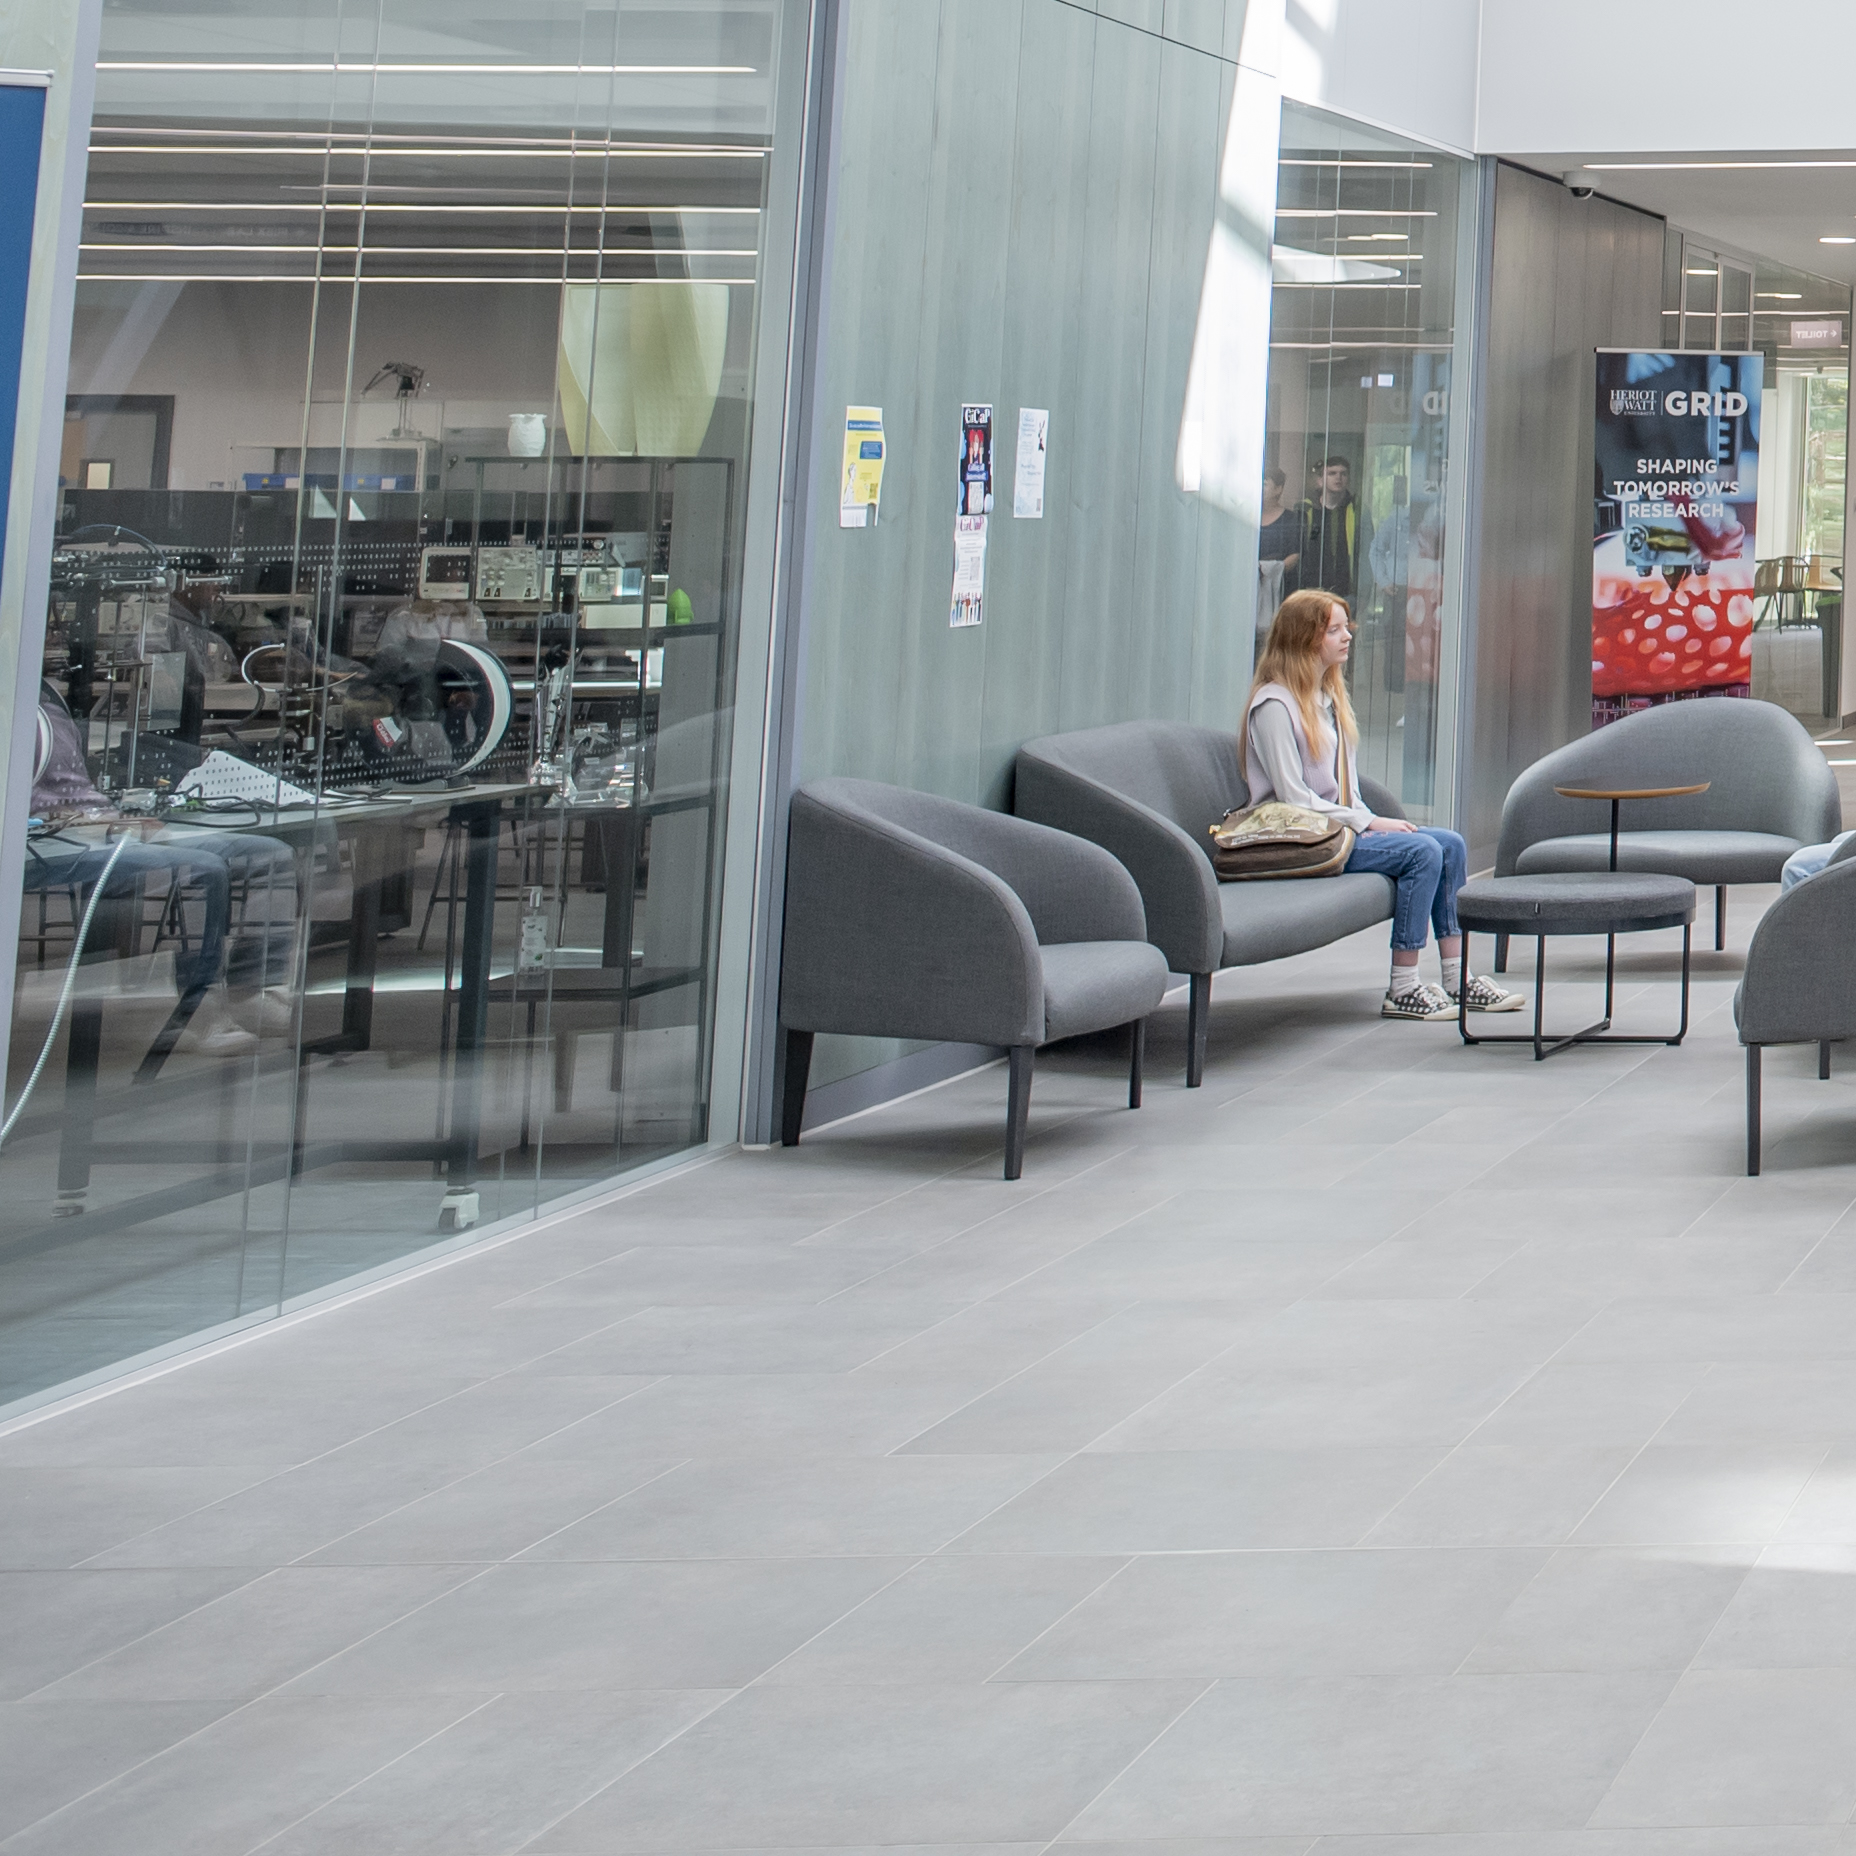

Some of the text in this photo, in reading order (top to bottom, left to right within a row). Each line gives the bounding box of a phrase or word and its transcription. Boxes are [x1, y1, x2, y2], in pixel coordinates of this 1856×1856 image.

[1610, 390, 1657, 400] HERIOT
[1624, 400, 1657, 410] WATT
[1665, 391, 1748, 416] GRID
[1637, 459, 1717, 474] SHAPING
[1613, 481, 1739, 496] TOMORROW'S
[1629, 503, 1724, 518] RESEARCH
